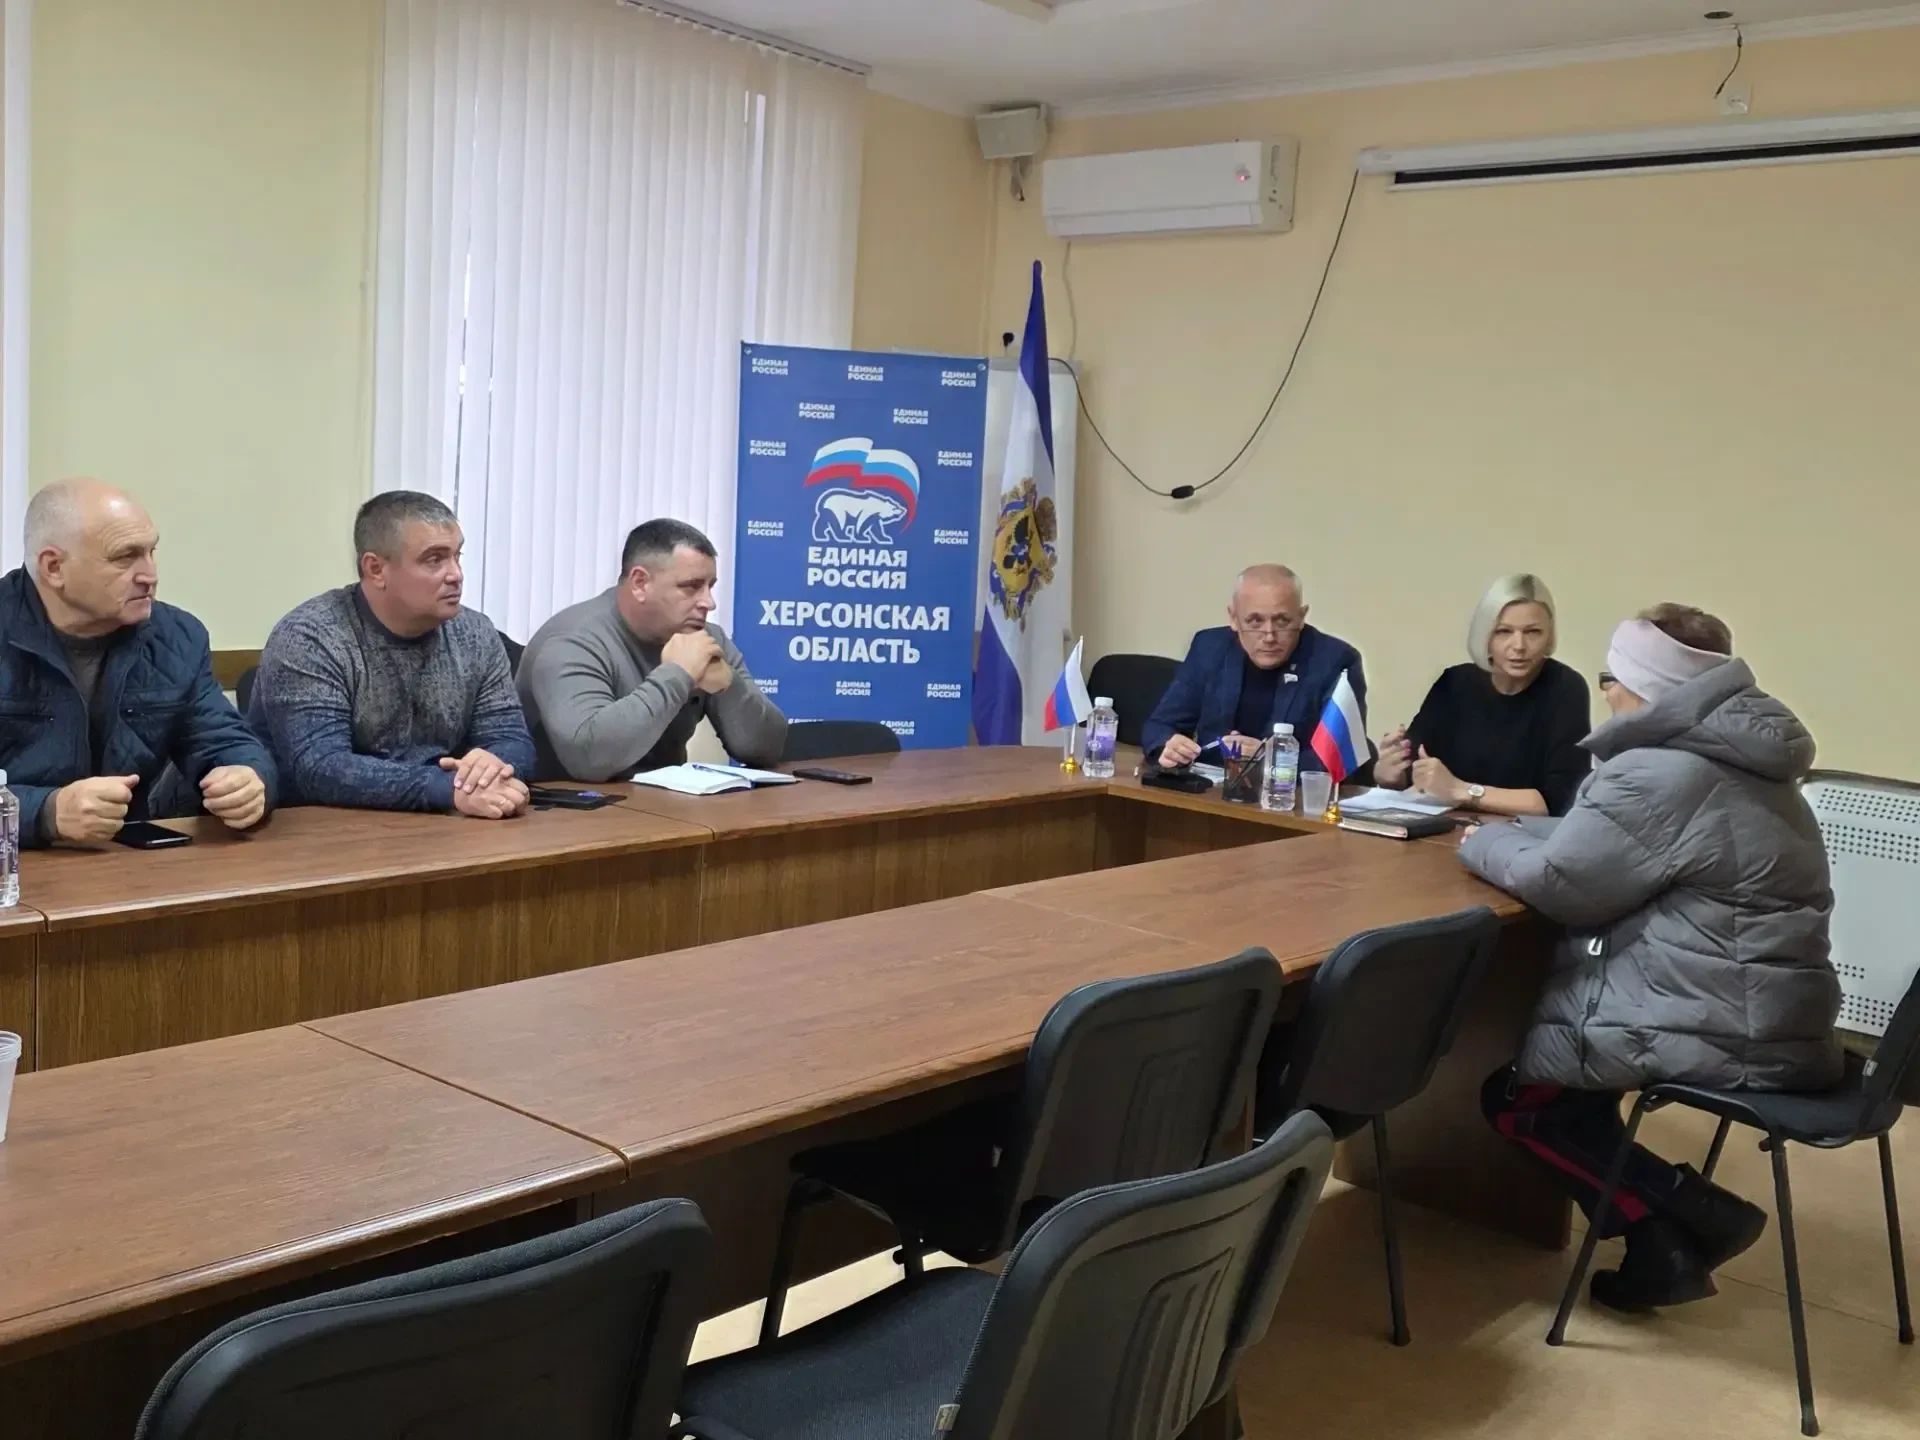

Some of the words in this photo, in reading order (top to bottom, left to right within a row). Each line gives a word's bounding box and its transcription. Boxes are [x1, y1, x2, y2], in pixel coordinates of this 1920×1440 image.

[752, 358, 788, 367] ЕДИНАЯ
[752, 366, 788, 375] РОССИЯ
[848, 365, 883, 374] ЕДИНАЯ
[848, 373, 883, 381] РОССИЯ
[941, 371, 976, 379] ЕДИНАЯ
[941, 378, 976, 387] РОССИЯ
[799, 402, 835, 411] ЕДИНАЯ
[799, 410, 835, 419] РОССИЯ
[893, 408, 928, 417] ЕДИНАЯ
[893, 416, 928, 425] РОССИЯ
[750, 440, 786, 448] ЕДИНАЯ
[750, 447, 786, 456] РОССИЯ
[938, 451, 972, 459] ЕДИНАЯ
[938, 457, 972, 467] РОССИЯ
[748, 521, 784, 529] ЕДИНАЯ
[748, 528, 784, 536] РОССИЯ
[934, 529, 968, 538] ЕДИНАЯ
[934, 536, 968, 544] РОССИЯ
[808, 547, 907, 567] ЕДИНАЯ
[807, 569, 906, 589] РОССИЯ
[759, 600, 950, 631] ХЕРСОНСКАЯ
[789, 636, 920, 663] ОБЛАСТЬ
[836, 681, 871, 690] ЕДИНАЯ
[927, 683, 961, 692] ЕДИНАЯ
[836, 688, 871, 696] РОССИЯ
[927, 691, 961, 699] РОССИЯ
